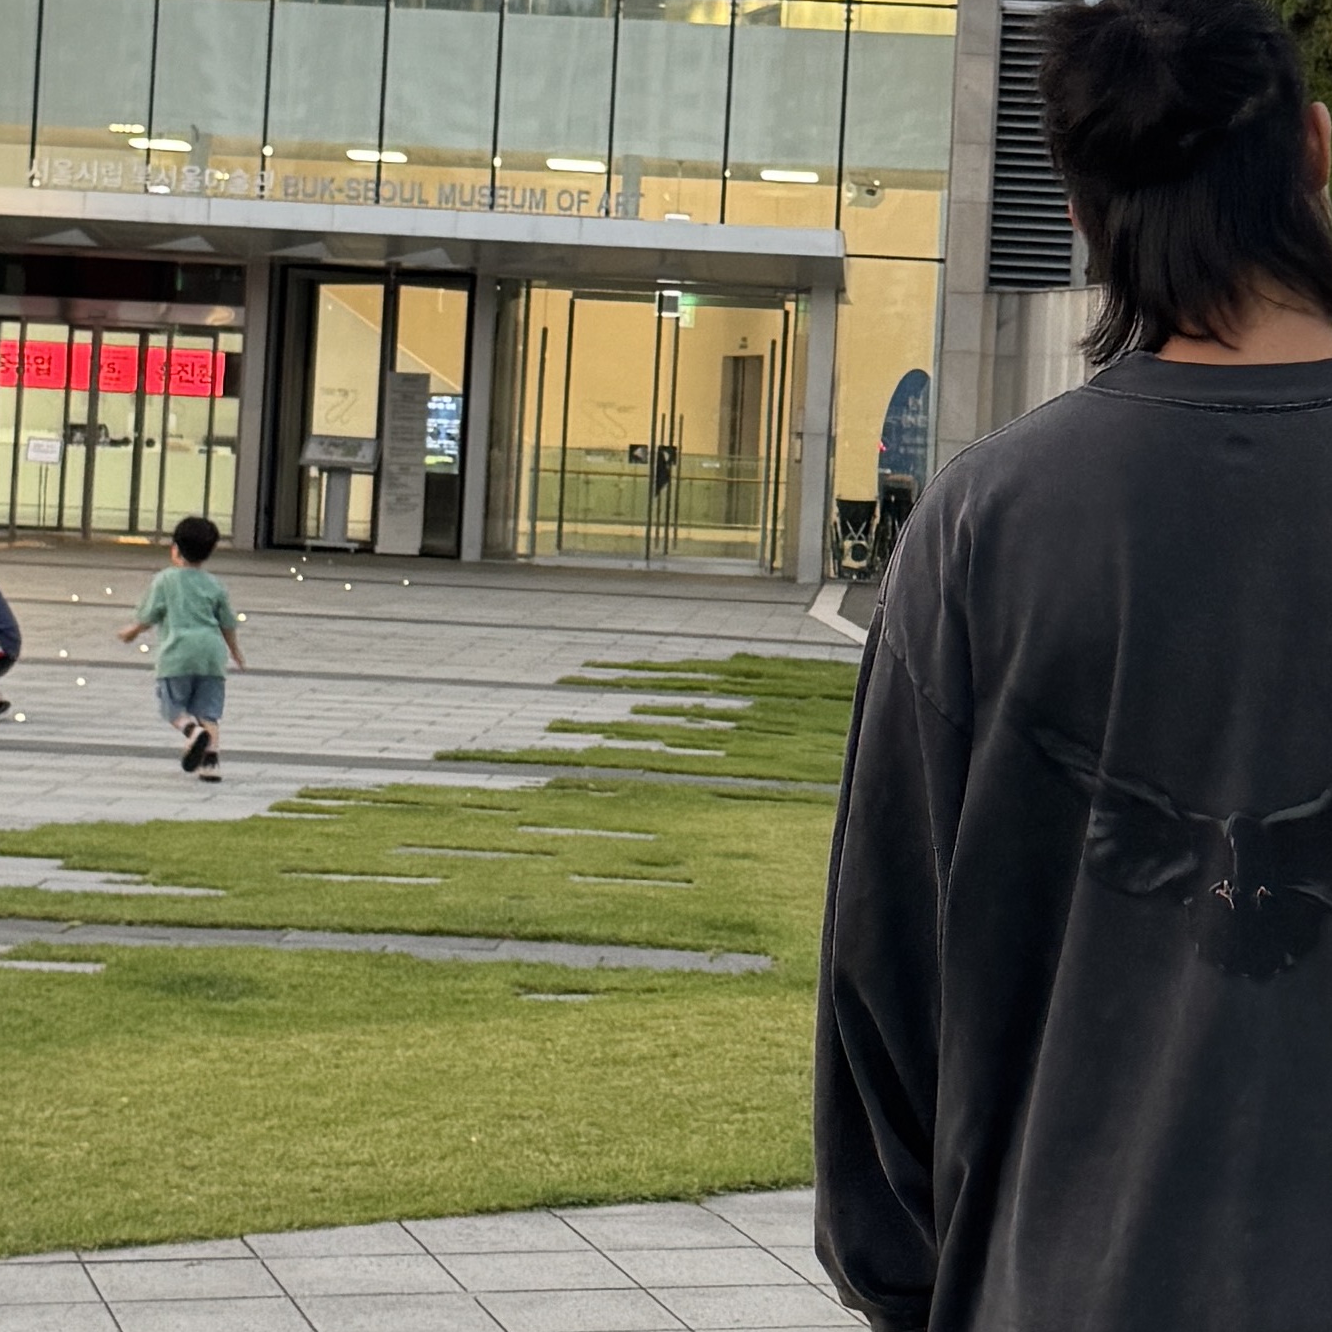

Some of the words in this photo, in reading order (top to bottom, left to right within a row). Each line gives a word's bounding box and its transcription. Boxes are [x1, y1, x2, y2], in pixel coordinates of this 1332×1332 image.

[29, 157, 122, 185] 서울시립
[282, 174, 429, 205] BUK-SEOUL
[437, 182, 547, 212] MUSEUM
[556, 189, 591, 213] OF
